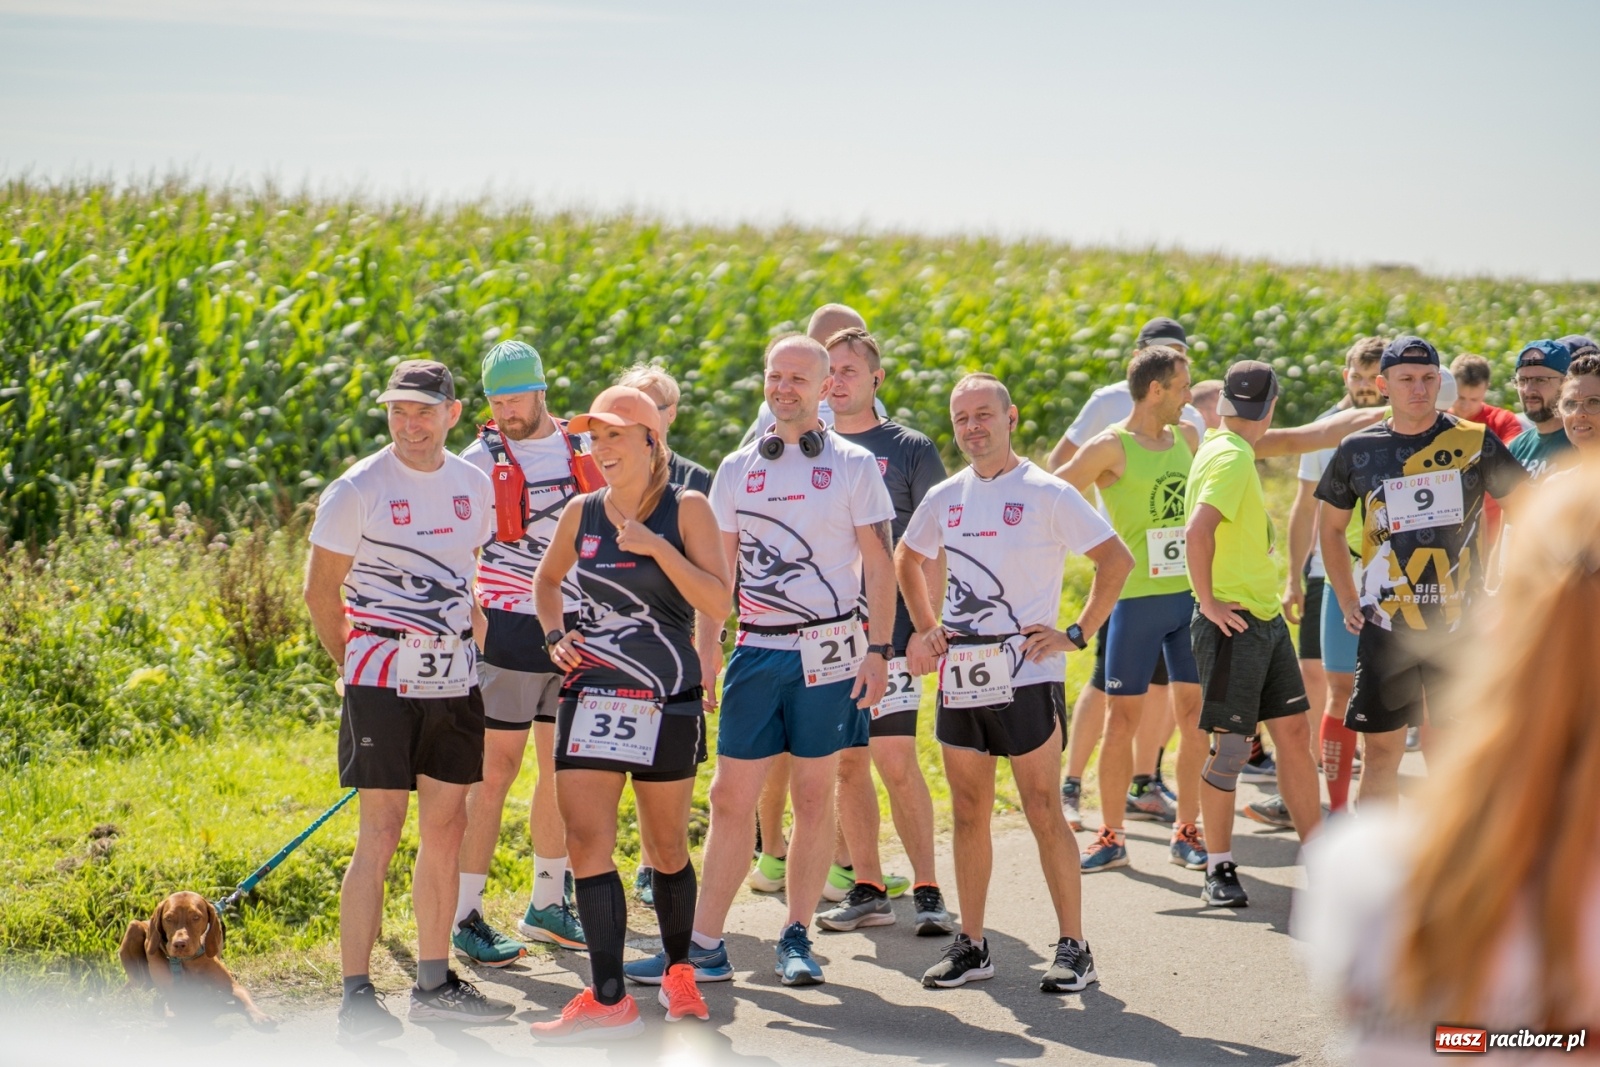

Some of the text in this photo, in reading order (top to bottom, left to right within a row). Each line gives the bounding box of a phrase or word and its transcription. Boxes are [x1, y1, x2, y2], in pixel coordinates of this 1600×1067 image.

[1390, 473, 1455, 491] COLOUR RUN
[1414, 488, 1435, 511] 9
[1163, 540, 1185, 560] 6
[1415, 584, 1446, 593] BIEG
[805, 625, 847, 641] COLOUR
[819, 635, 857, 665] 21
[979, 647, 1000, 660] RUN
[417, 653, 454, 678] 37
[950, 662, 991, 689] 16
[583, 701, 656, 716] COLOUR RUN
[589, 713, 638, 740] 35
